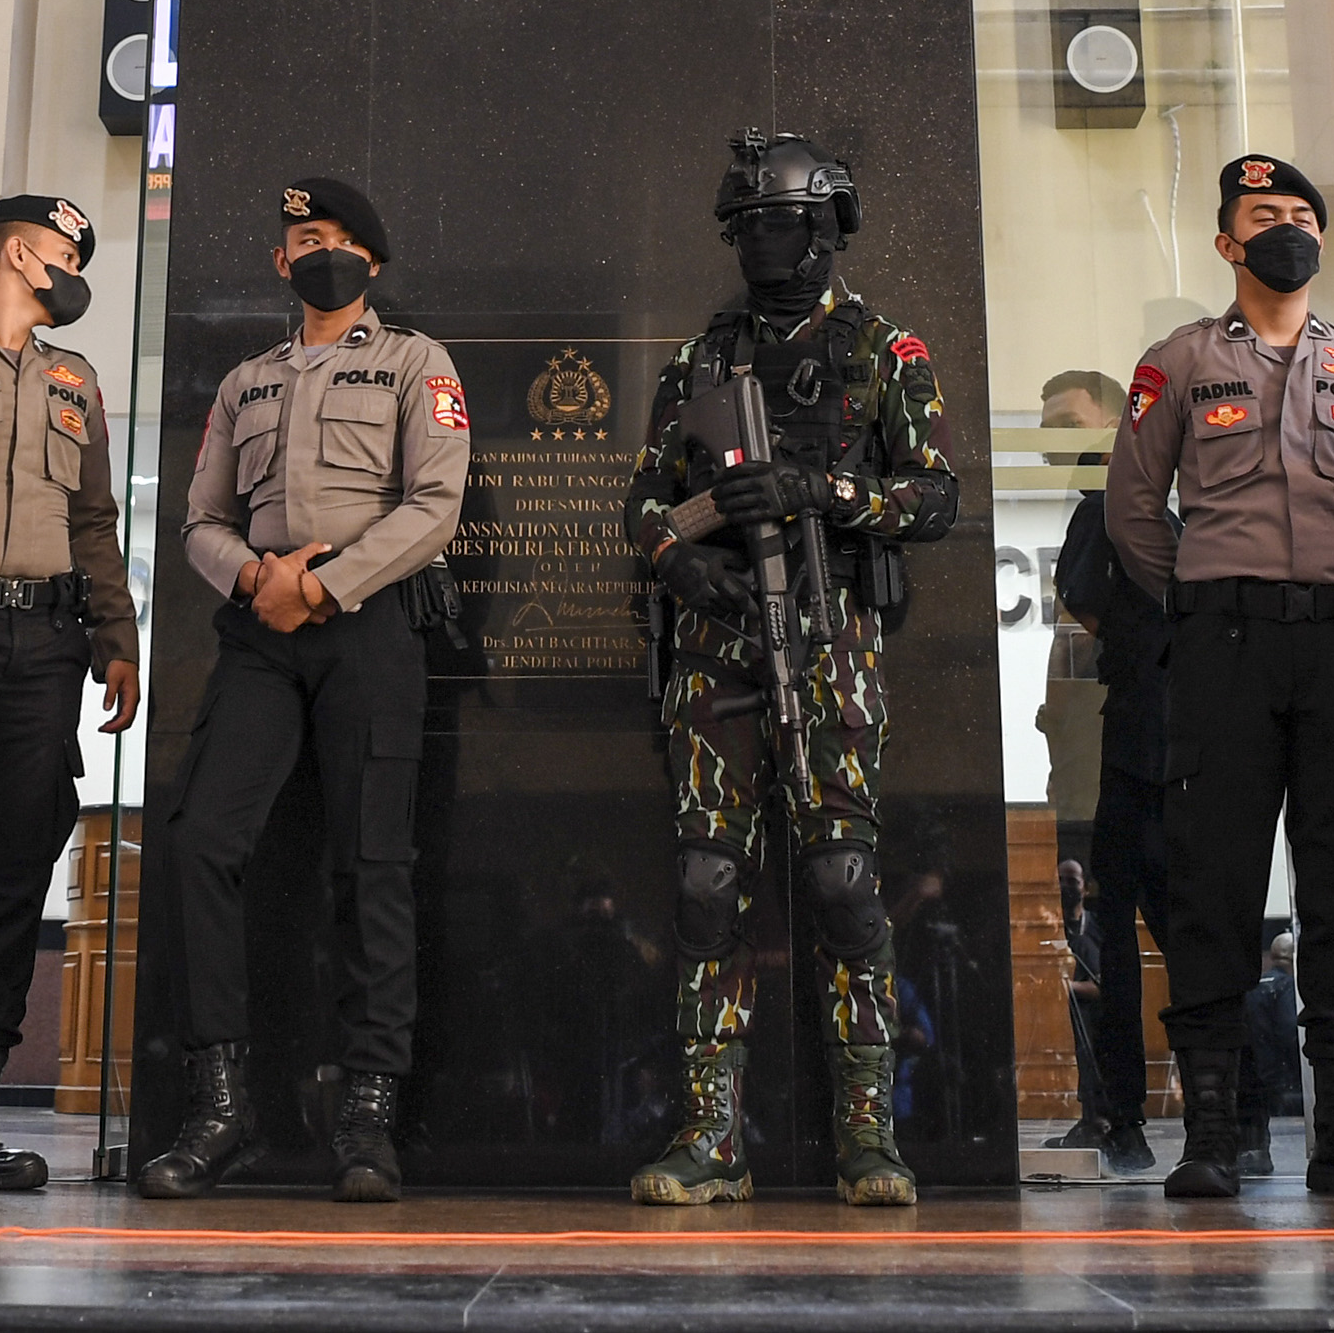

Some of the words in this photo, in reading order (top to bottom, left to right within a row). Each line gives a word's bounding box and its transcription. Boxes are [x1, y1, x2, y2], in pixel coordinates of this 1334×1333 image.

[332, 369, 396, 388] POLRI
[48, 383, 88, 414] POLRI
[238, 382, 284, 408] ADIT
[1191, 380, 1253, 404] FADHIL
[500, 452, 552, 463] RAHMAT
[556, 452, 596, 463] TUHAN
[599, 452, 632, 463] YANG
[478, 474, 503, 488] INI
[512, 474, 560, 488] RABU
[489, 540, 543, 556] POLRI
[462, 580, 536, 594] KEPOLISIAN
[541, 581, 594, 594] NEGARA
[502, 655, 578, 668] JENDERAL
